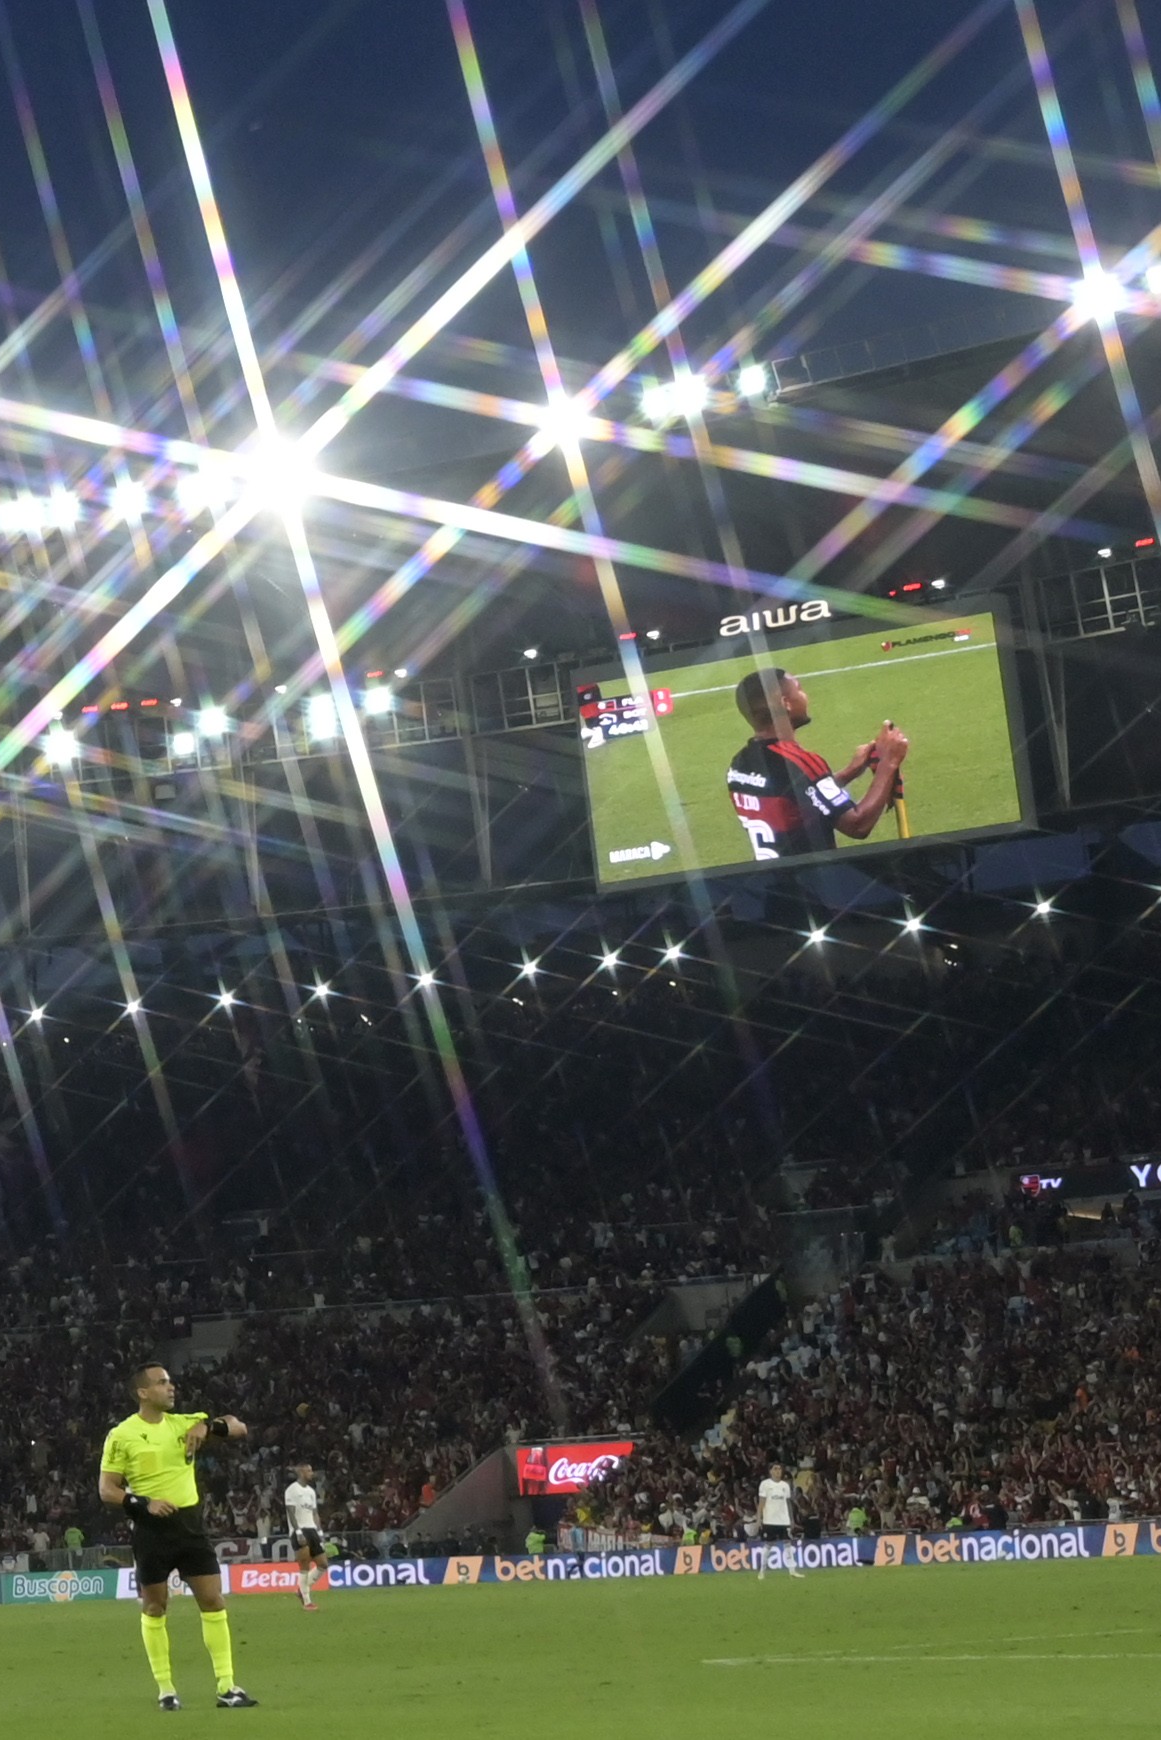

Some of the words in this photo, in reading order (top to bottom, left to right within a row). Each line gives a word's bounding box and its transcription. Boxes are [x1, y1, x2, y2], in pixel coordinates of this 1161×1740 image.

[719, 599, 832, 637] aiwa
[915, 1526, 1090, 1564] betnacional
[494, 1549, 664, 1582] betnacional
[13, 1574, 105, 1600] Buscopan
